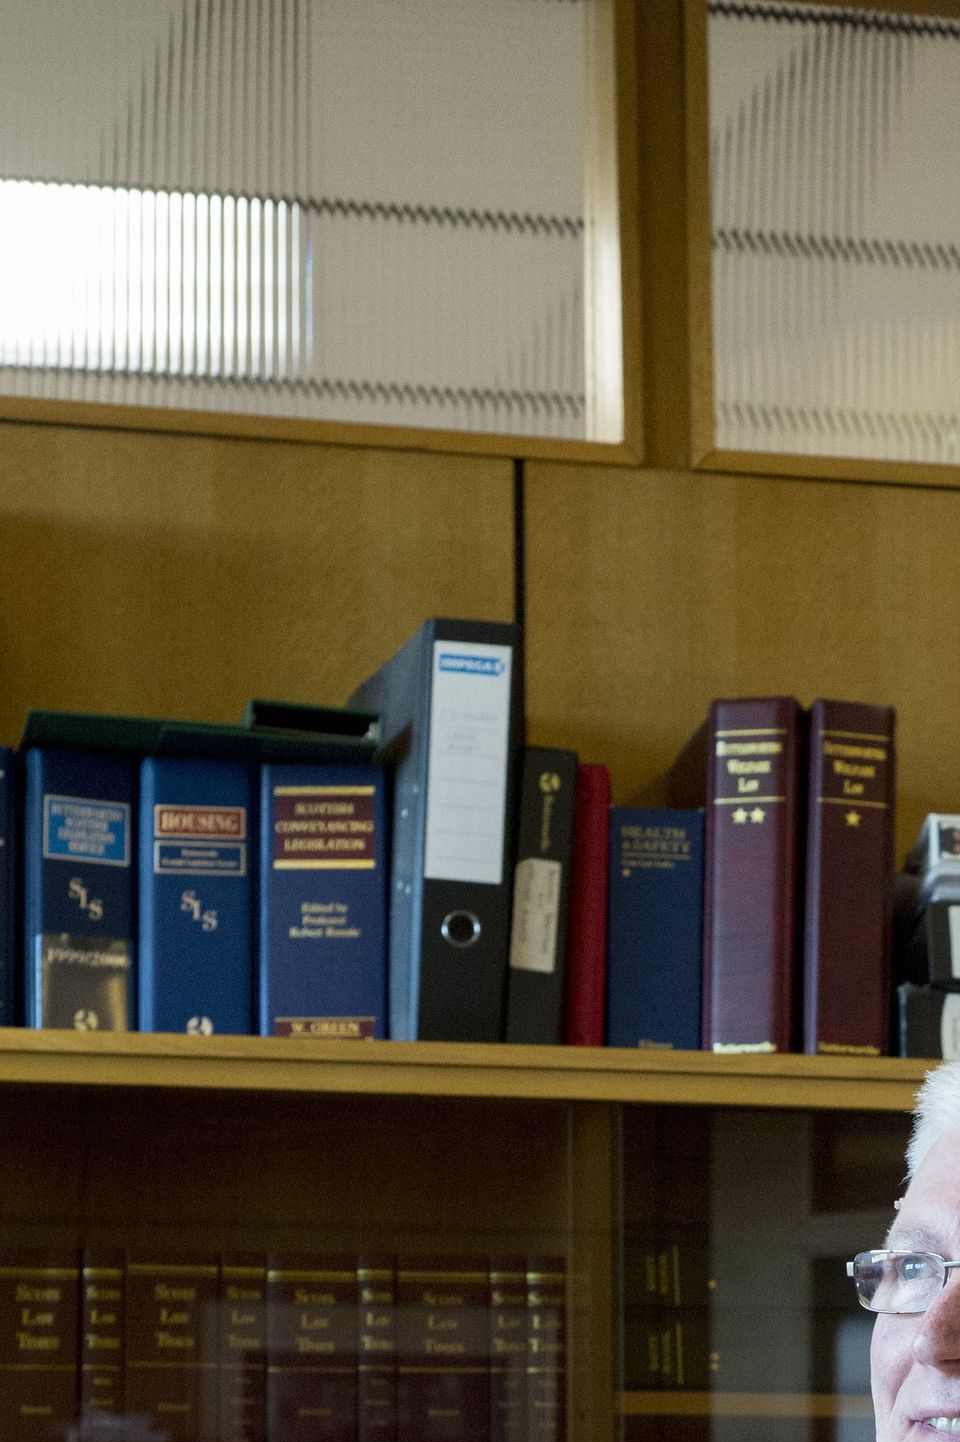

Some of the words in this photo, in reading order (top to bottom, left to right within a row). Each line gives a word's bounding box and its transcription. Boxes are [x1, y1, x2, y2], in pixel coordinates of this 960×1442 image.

[160, 811, 239, 833] HOUSING
[283, 837, 366, 852] LEGISLATION
[310, 1022, 361, 1034] GREEN
